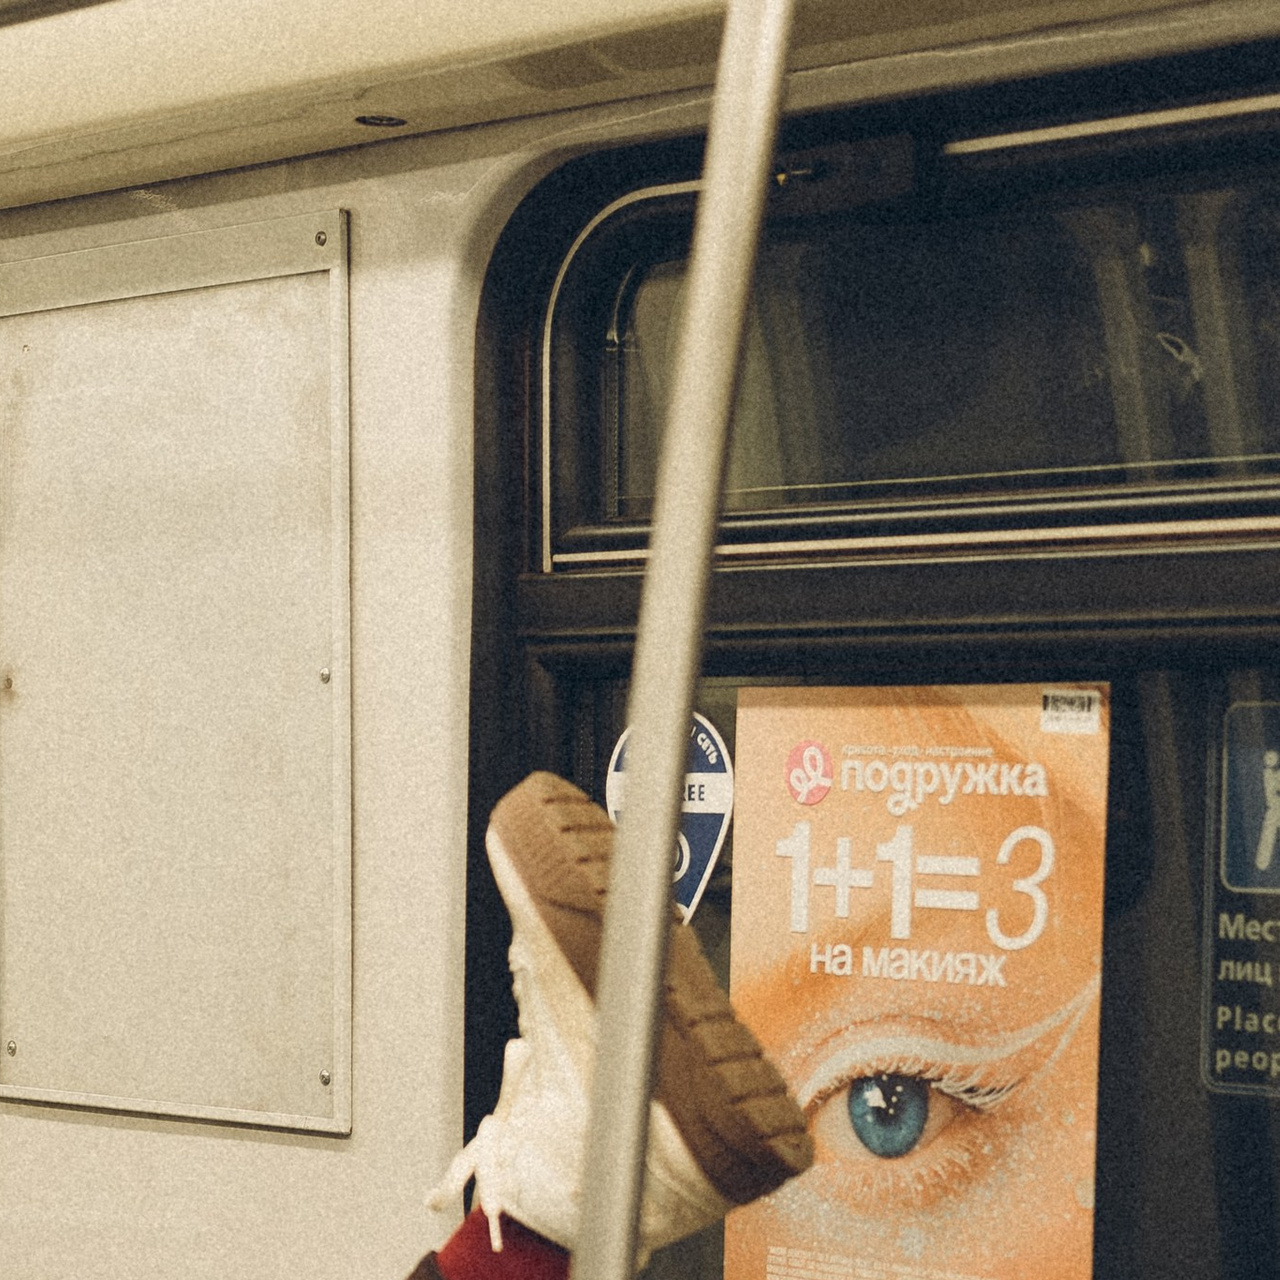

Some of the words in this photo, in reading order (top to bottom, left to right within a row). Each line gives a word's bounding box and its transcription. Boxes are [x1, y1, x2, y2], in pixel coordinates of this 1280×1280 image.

[696, 732, 719, 766] СЕТЬ
[839, 758, 1049, 817] подружка
[1218, 911, 1280, 943] Мес
[809, 942, 853, 977] на
[861, 945, 1008, 988] макияж
[1217, 959, 1274, 988] лиц
[1216, 1004, 1280, 1035] Plac
